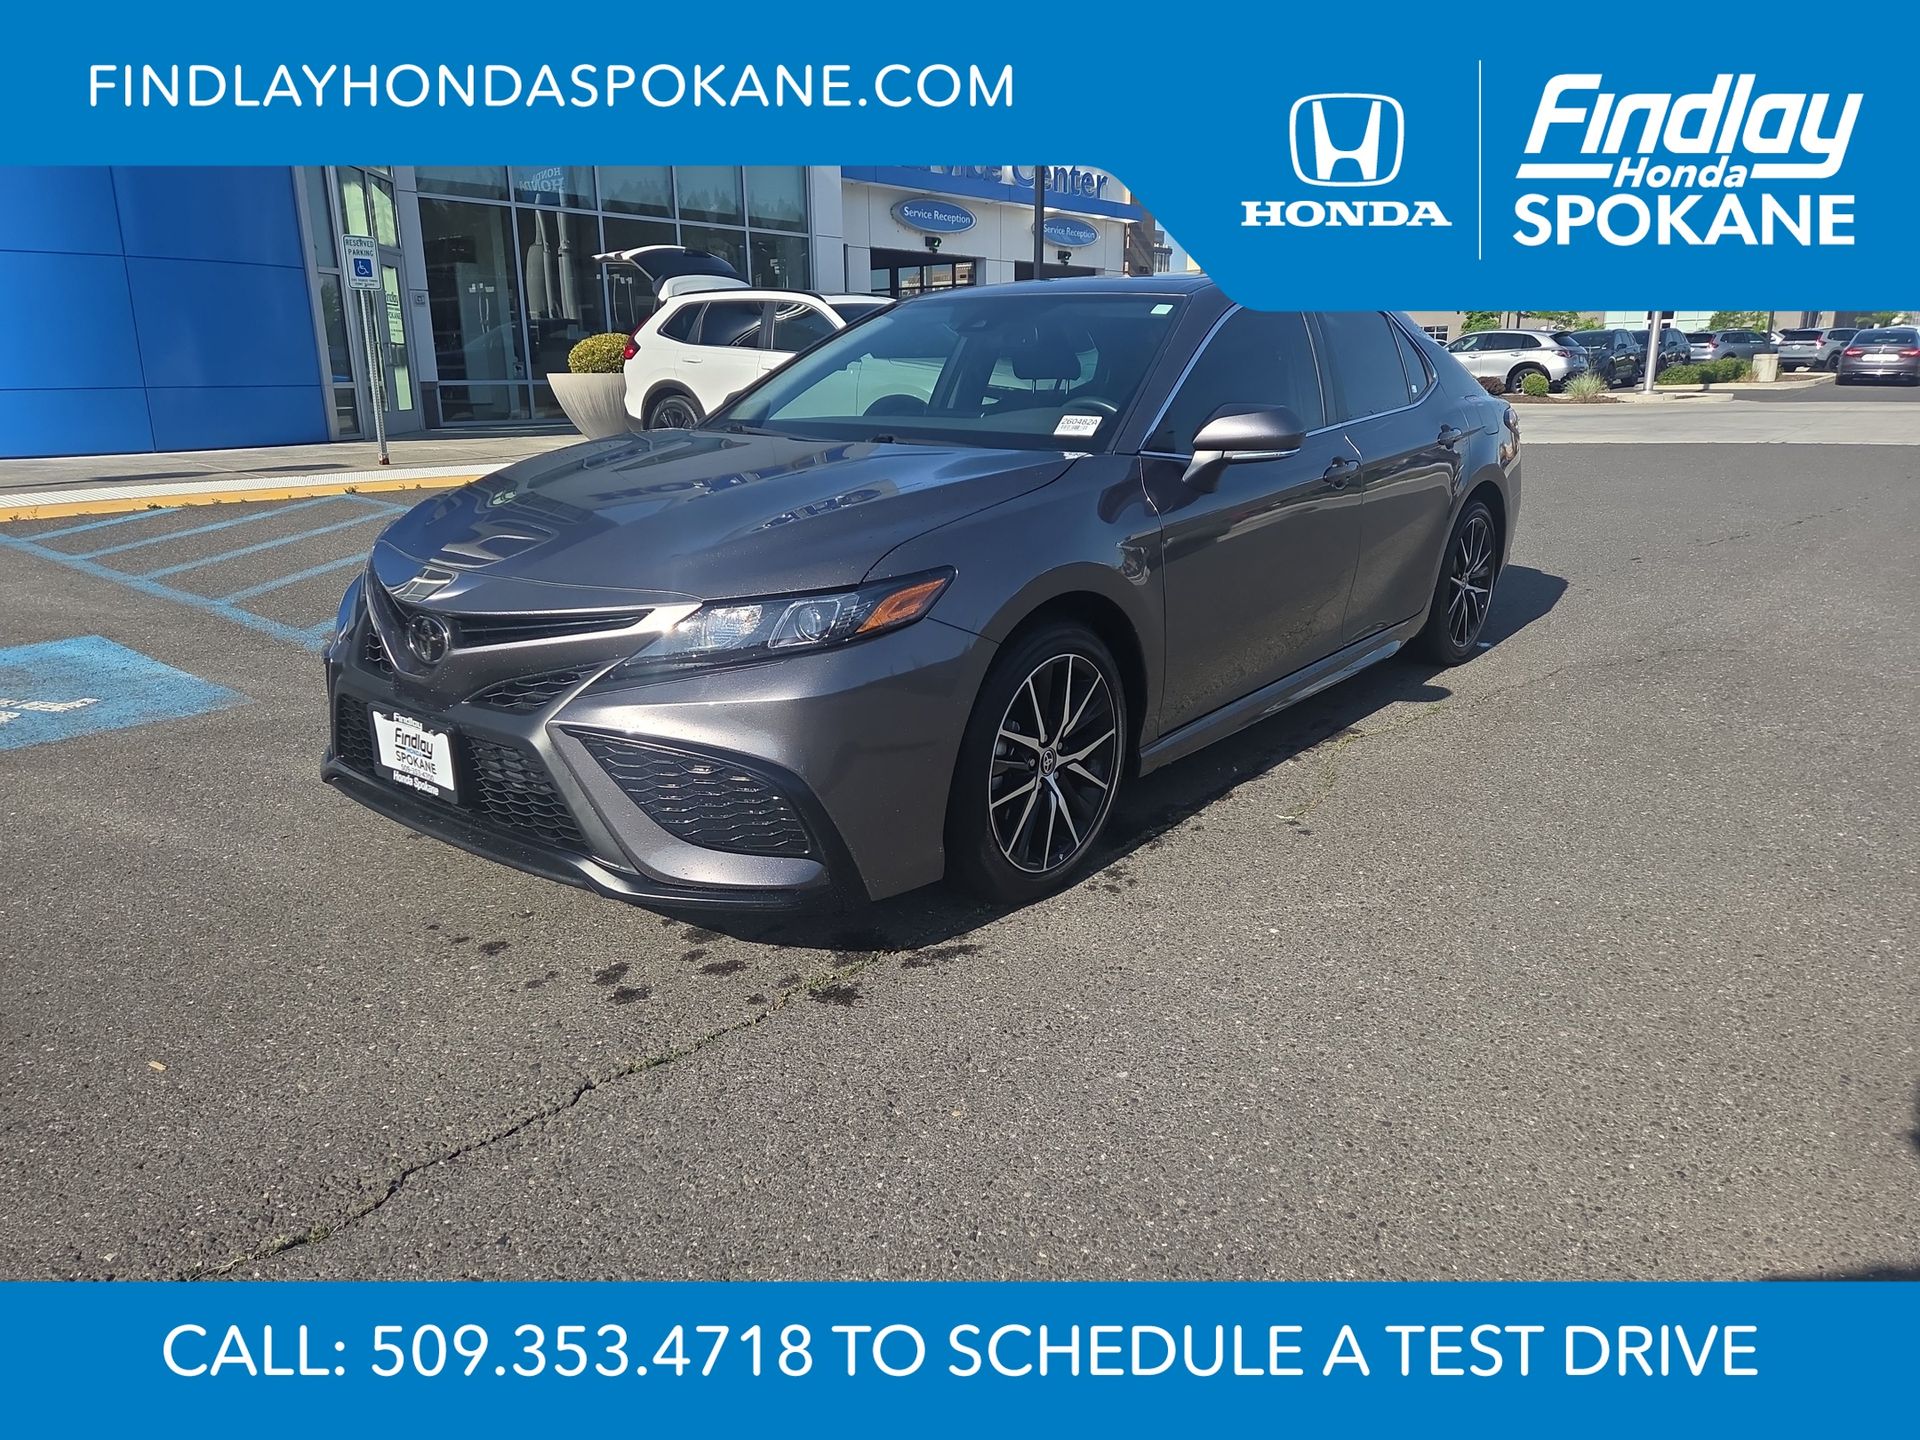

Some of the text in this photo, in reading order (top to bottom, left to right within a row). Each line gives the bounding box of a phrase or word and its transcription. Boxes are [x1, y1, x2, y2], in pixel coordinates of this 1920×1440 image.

[903, 206, 971, 225] Service Reception
[1043, 223, 1096, 240] Service Reception
[345, 238, 375, 249] RESERVED
[348, 248, 374, 257] PARKING
[394, 727, 434, 760] Findlay
[395, 750, 438, 775] SPOKANE
[393, 770, 413, 786] Honda
[414, 777, 439, 796] Spokane
